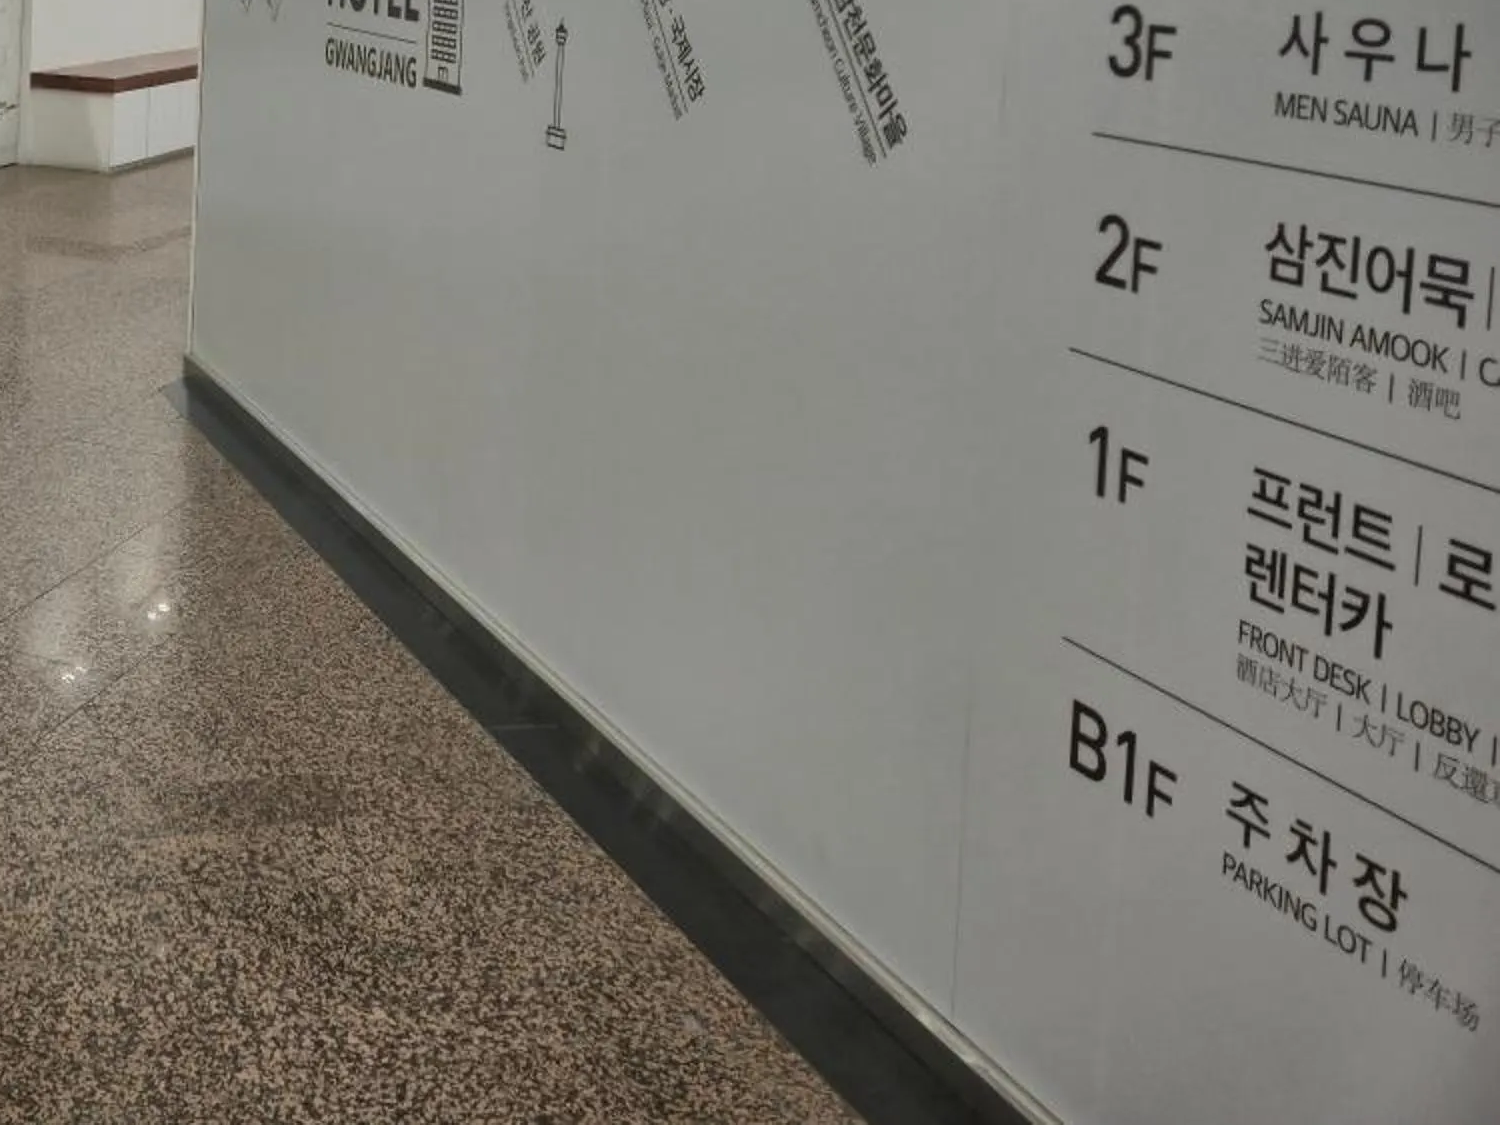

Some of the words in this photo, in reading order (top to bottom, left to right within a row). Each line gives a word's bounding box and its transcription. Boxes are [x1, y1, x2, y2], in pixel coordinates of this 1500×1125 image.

[324, 37, 417, 89] GWANGJANG
[1108, 4, 1178, 81] 3F
[1274, 91, 1329, 125] MEN
[1333, 98, 1419, 138] SAUNA
[1094, 213, 1164, 294] 2F
[1264, 221, 1475, 330] 삼진어묵
[1257, 298, 1345, 344] SAMJIN
[1349, 324, 1450, 374] AMOOK
[1088, 425, 1150, 504] 1F
[1246, 466, 1397, 572] 프런트
[1438, 538, 1497, 612] 로
[1244, 542, 1394, 661] 렌터카
[1237, 619, 1310, 673] FRONT
[1312, 653, 1371, 706] DESK
[1397, 690, 1482, 754] LOBBY
[1069, 697, 1178, 818] B1F
[1222, 850, 1319, 933] PARKING
[1323, 913, 1373, 964] LOT
